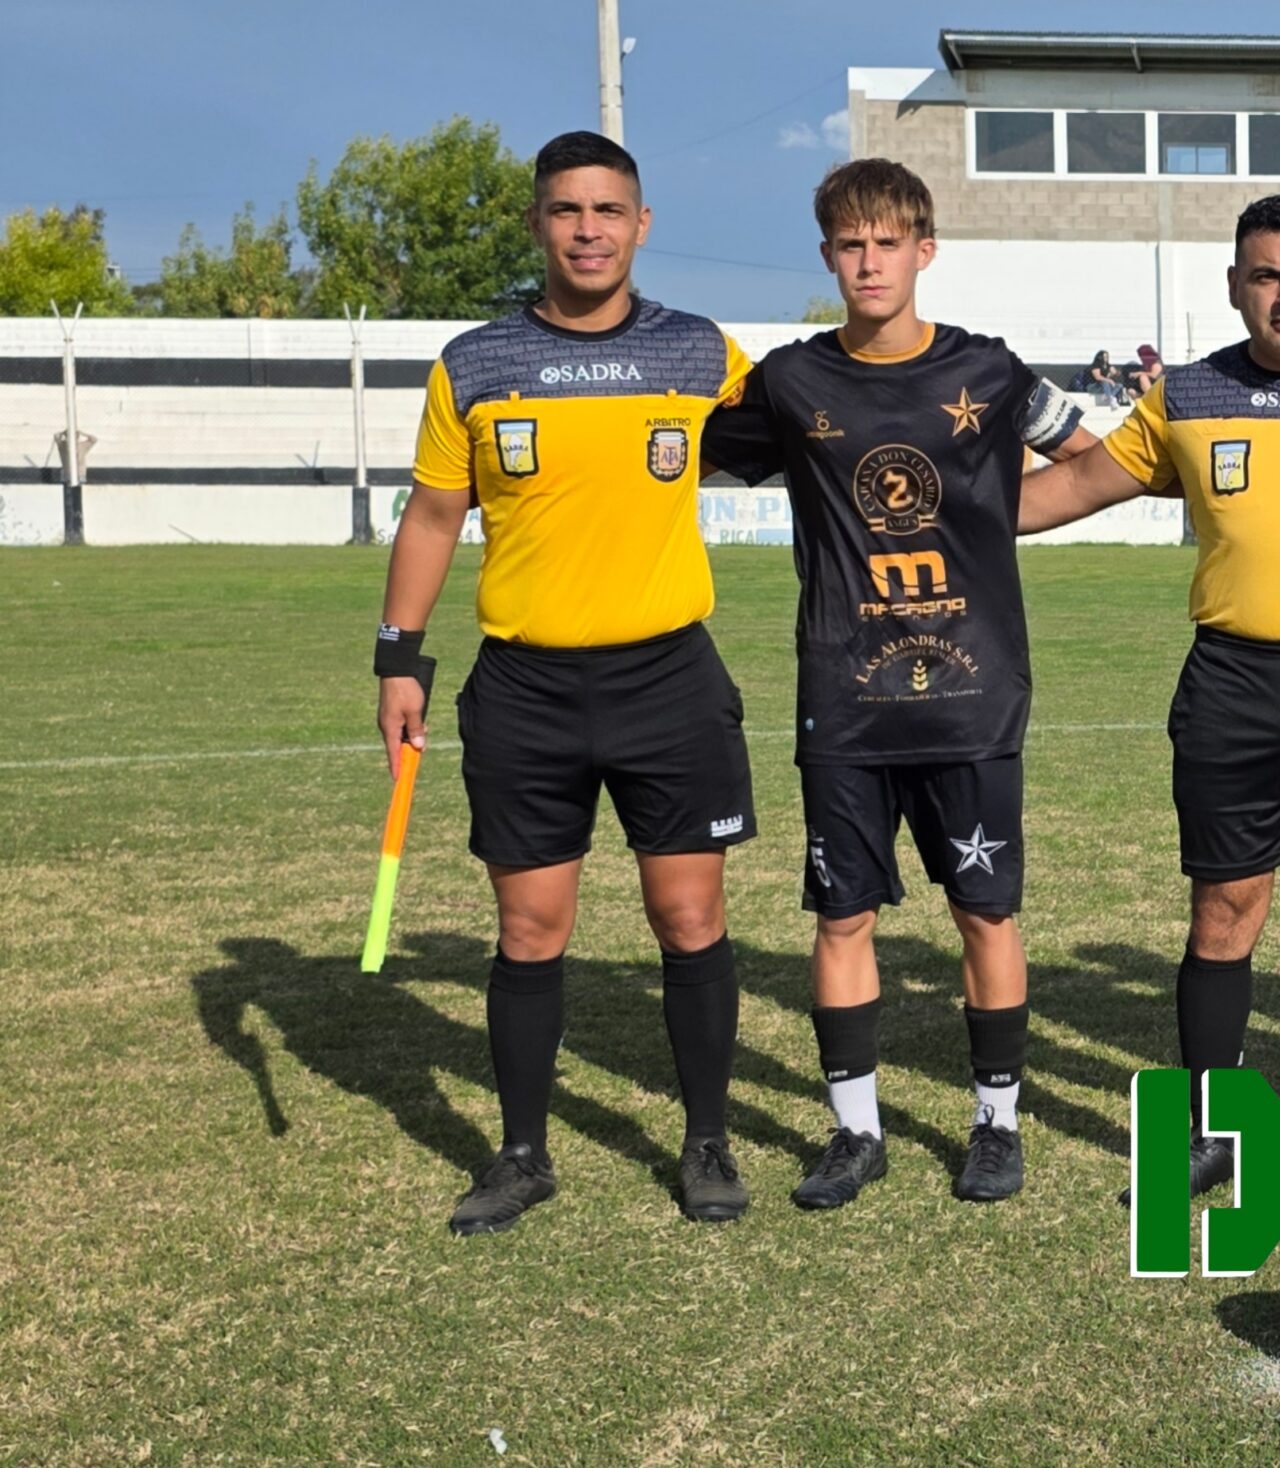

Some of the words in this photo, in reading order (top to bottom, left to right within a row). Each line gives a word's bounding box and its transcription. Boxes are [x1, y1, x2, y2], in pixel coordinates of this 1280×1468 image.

[561, 363, 642, 382] SADRA
[645, 418, 691, 427] ARBITRO
[856, 656, 880, 684] LAS
[882, 635, 952, 659] ALONDRAS
